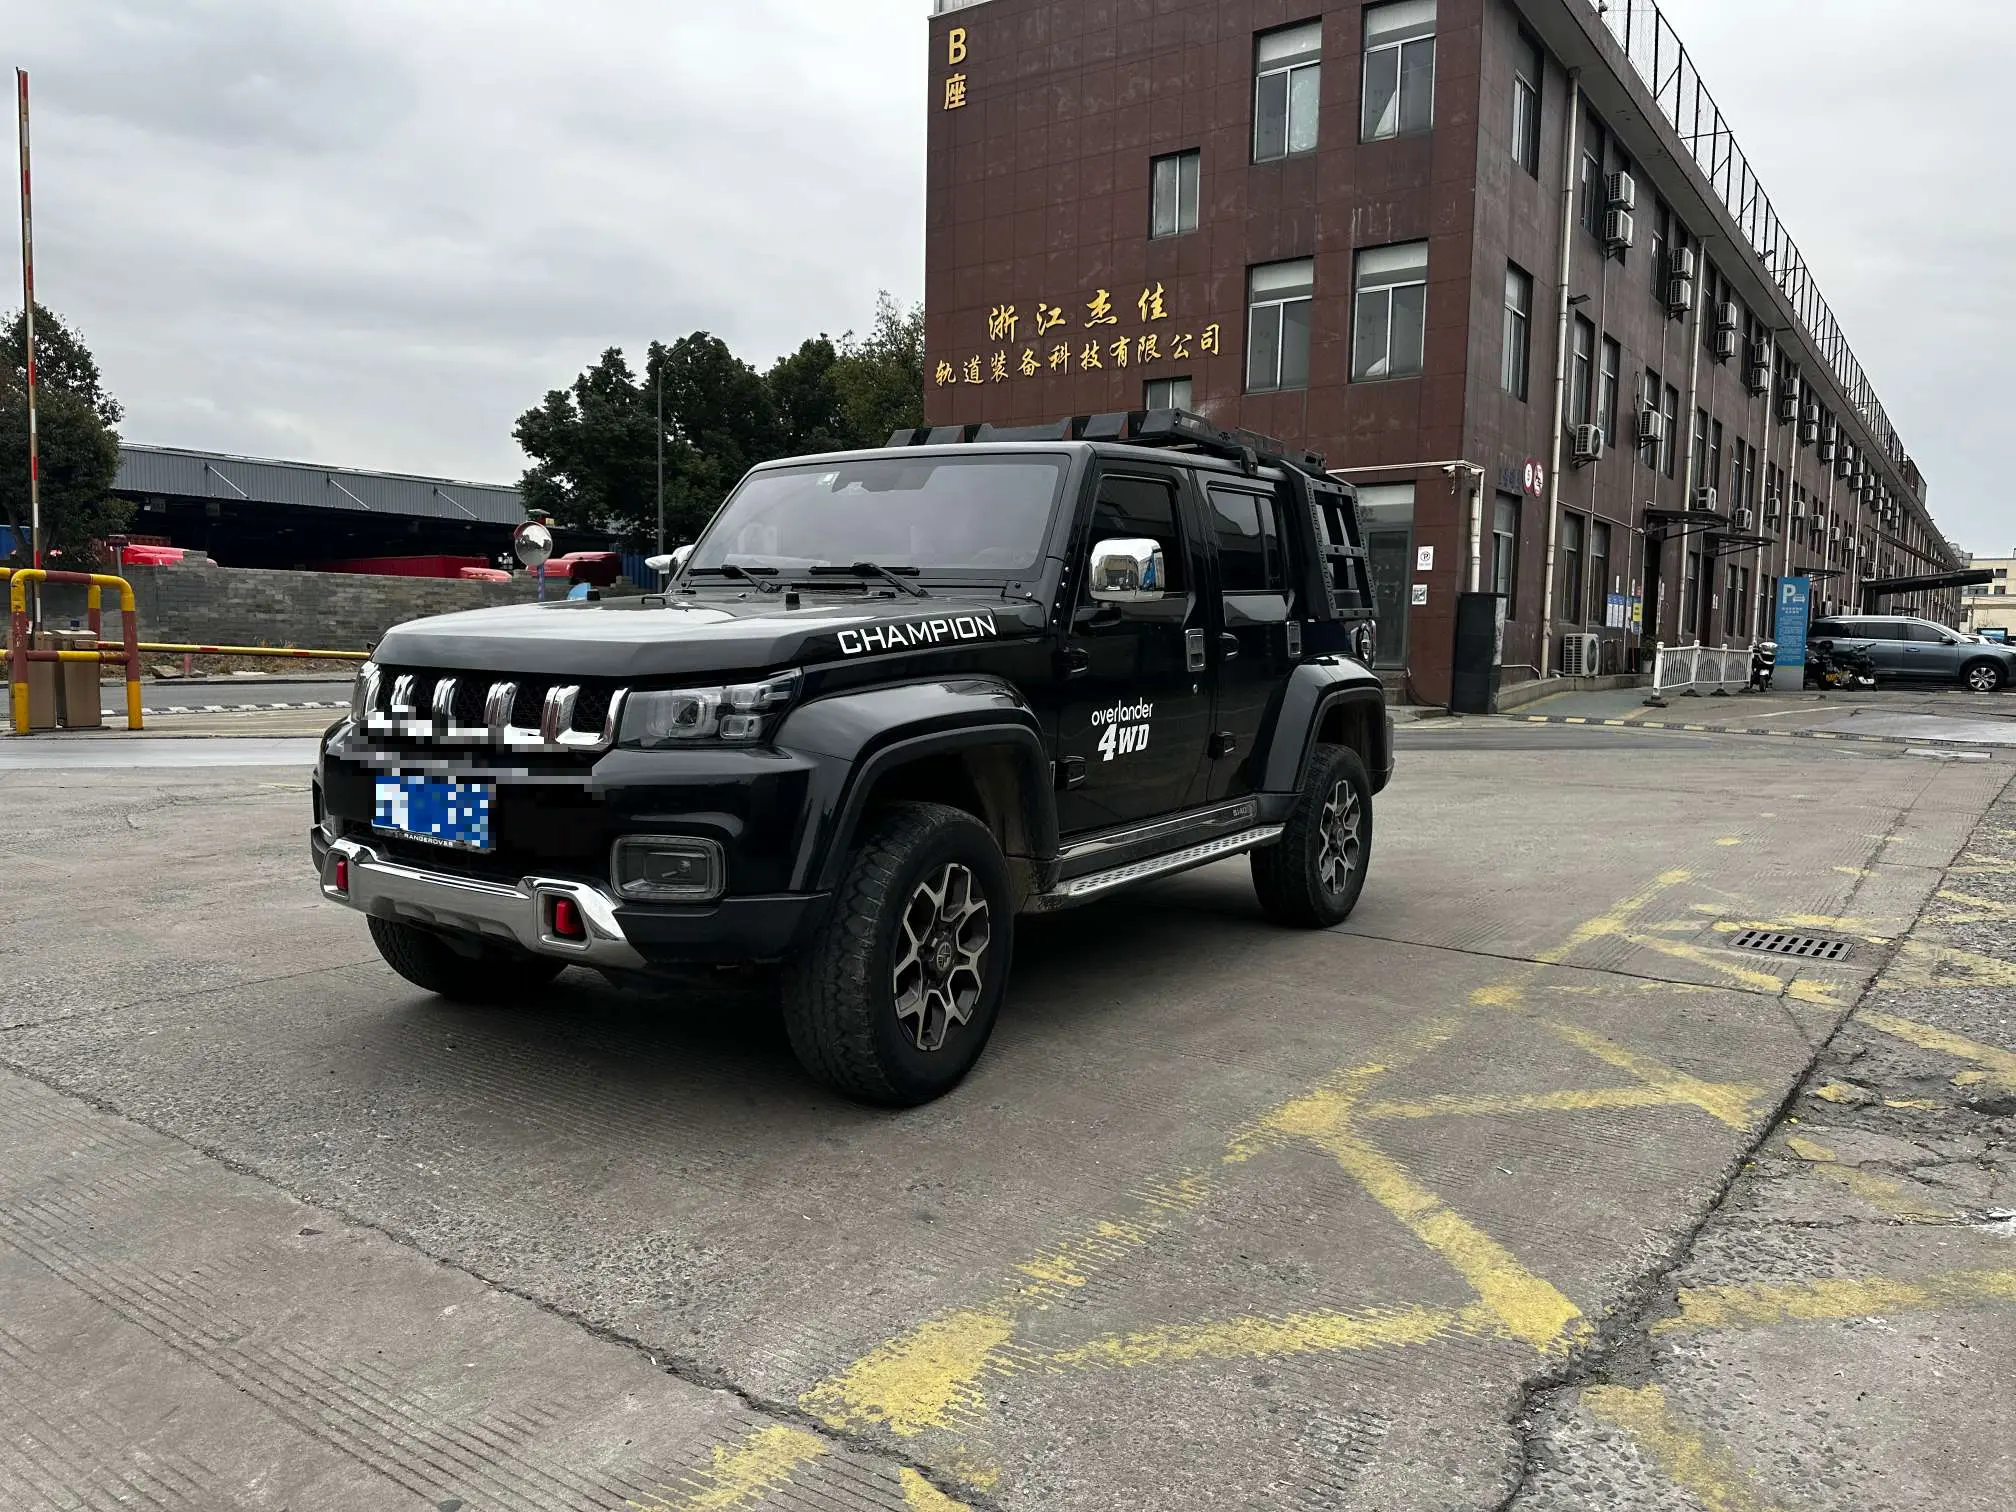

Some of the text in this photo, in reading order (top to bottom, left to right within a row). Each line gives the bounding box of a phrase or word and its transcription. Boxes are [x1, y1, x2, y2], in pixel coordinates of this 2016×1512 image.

[944, 27, 966, 110] B座
[988, 281, 1168, 343] 浙江杰佳
[935, 323, 1220, 387] 轨道装备科技有限公司
[1782, 583, 1796, 604] P
[837, 615, 997, 654] CHAMPION
[1091, 696, 1153, 726] overlander
[1097, 723, 1150, 761] 4WD
